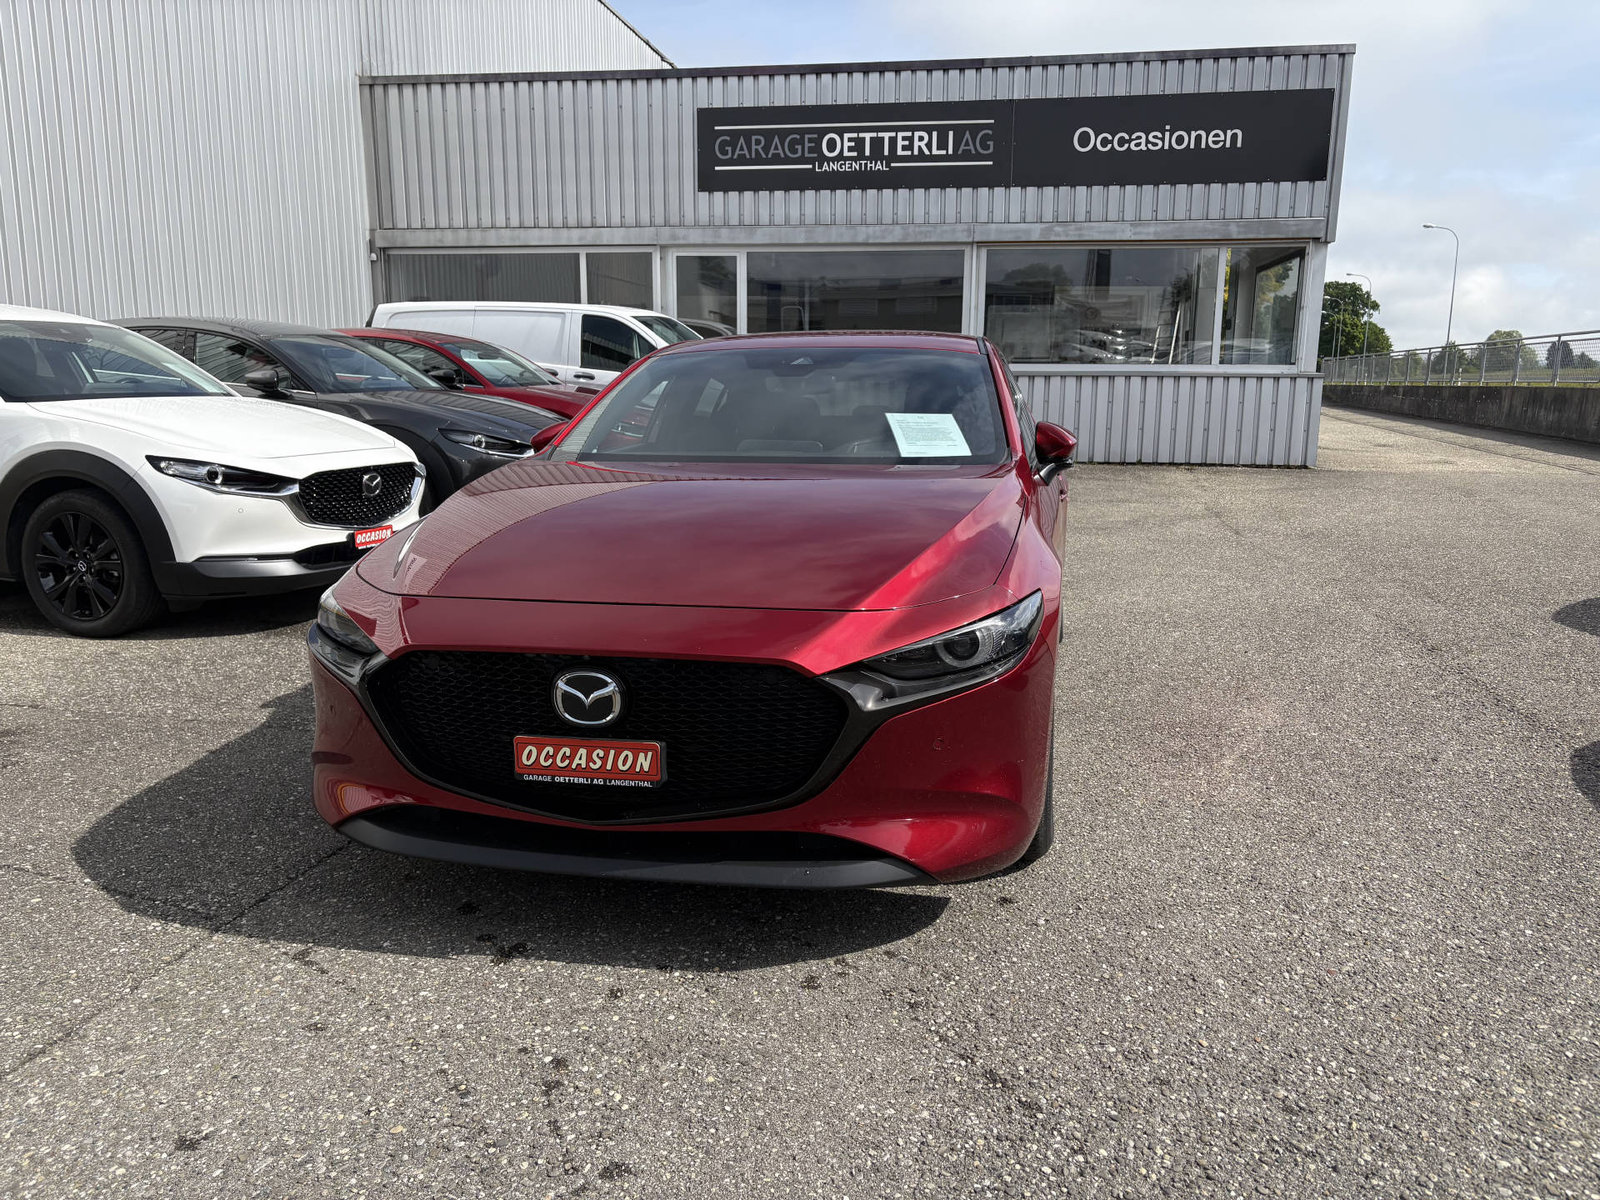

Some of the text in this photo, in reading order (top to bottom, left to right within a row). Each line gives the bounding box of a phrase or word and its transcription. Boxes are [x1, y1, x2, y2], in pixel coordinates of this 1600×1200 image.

[714, 129, 994, 159] GARAGE OETTERLI AG
[1073, 125, 1243, 152] Occasionen
[815, 160, 890, 172] LANGENTHAL
[356, 528, 392, 543] OCCASION
[521, 745, 652, 772] OCCASION
[523, 774, 552, 782] GARAGE
[554, 776, 591, 785] OETTERLI
[606, 779, 653, 788] LANGENTHAL
